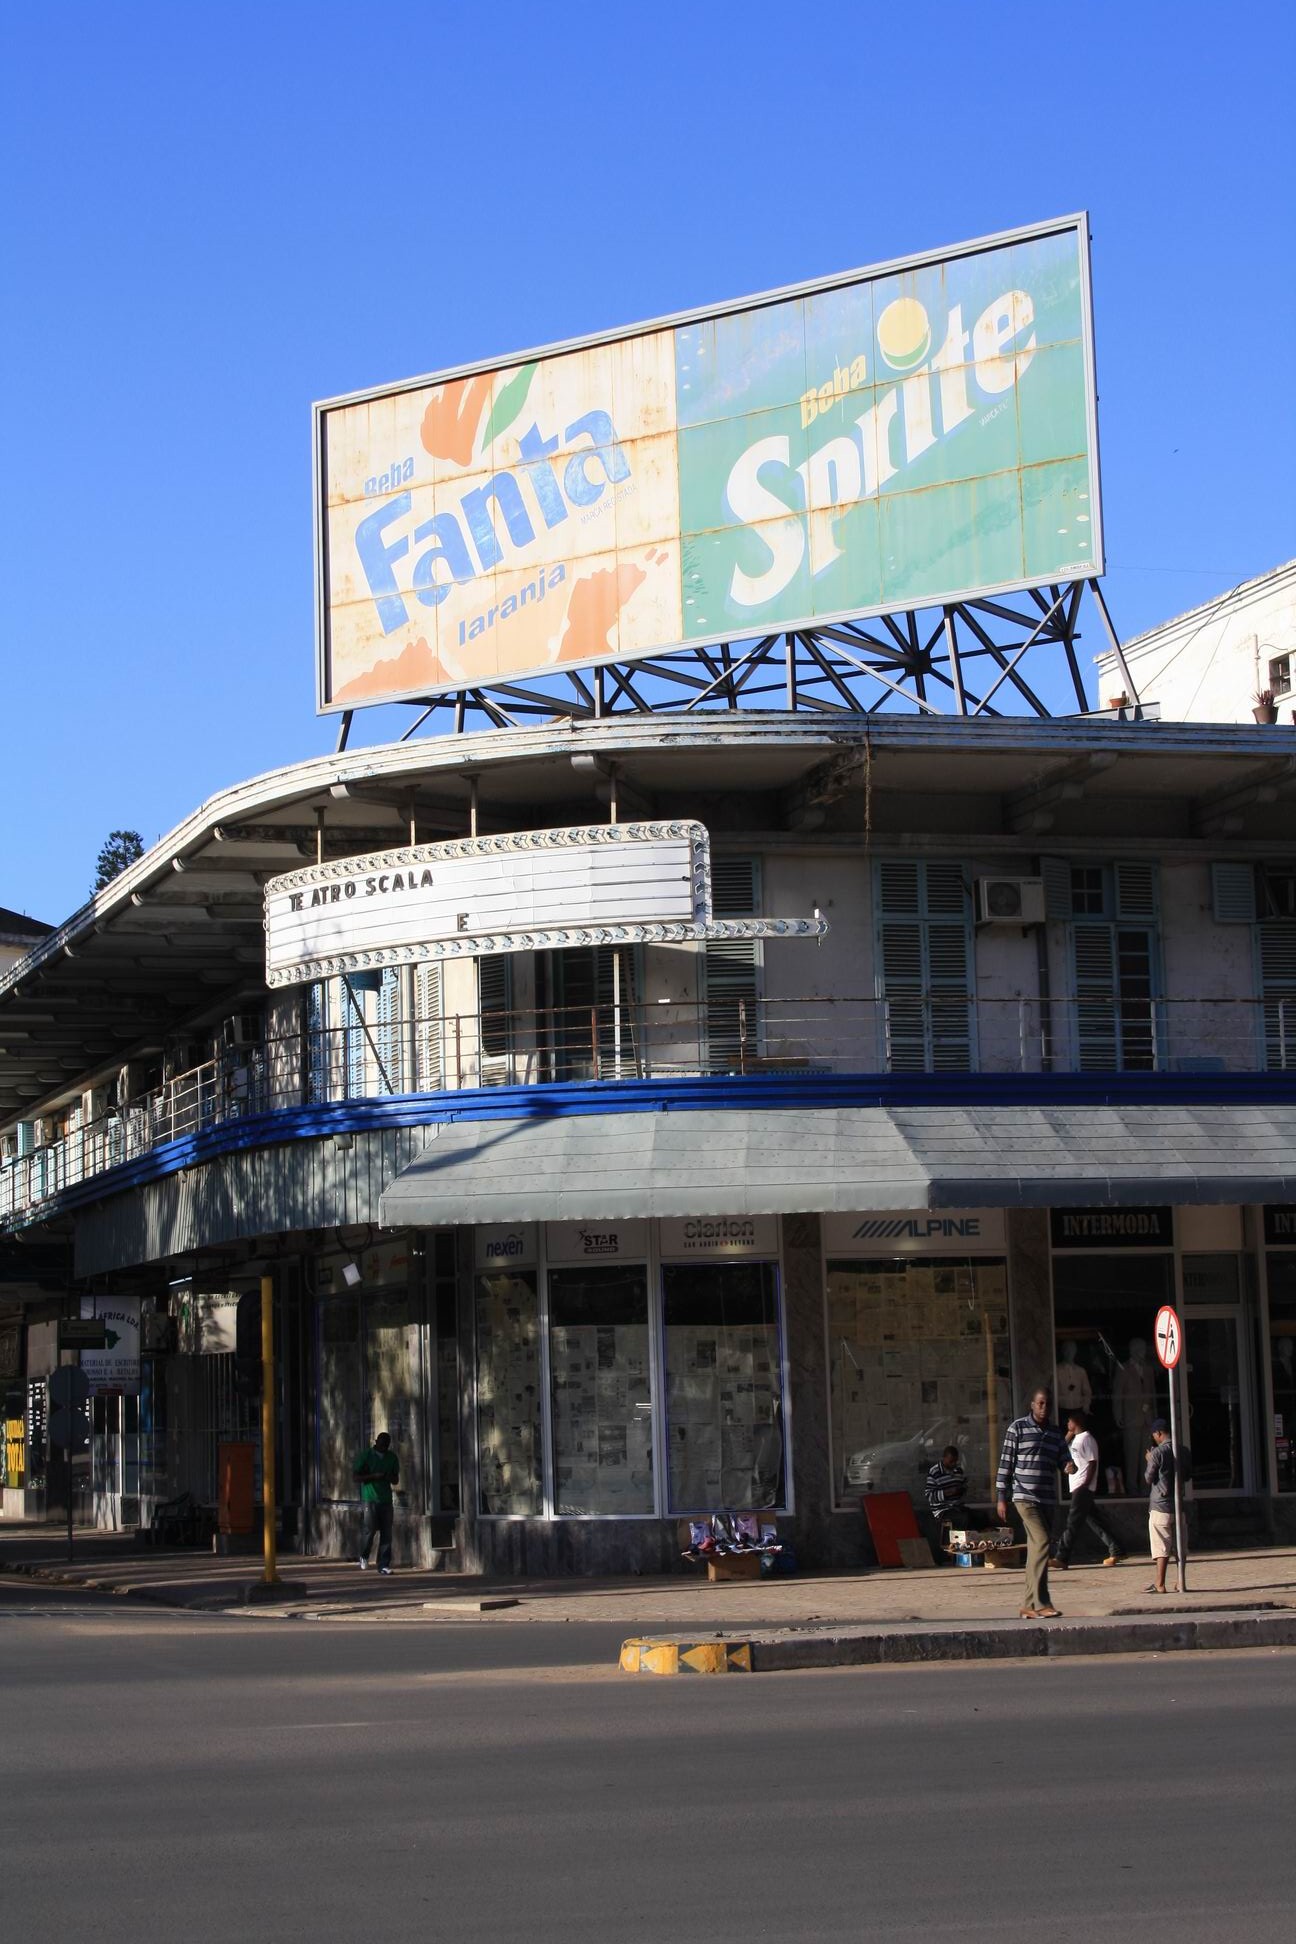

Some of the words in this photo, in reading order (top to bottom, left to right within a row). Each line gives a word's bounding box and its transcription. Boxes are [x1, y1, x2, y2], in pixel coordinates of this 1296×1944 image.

[727, 290, 1036, 606] Sprite
[355, 409, 631, 635] Fanta
[459, 562, 567, 646] laranja
[366, 869, 433, 896] SCALA
[457, 913, 470, 933] E
[684, 1219, 754, 1238] clarion
[889, 1219, 980, 1238] ALPINE
[1063, 1213, 1160, 1236] INTERMODA
[486, 1239, 523, 1257] nexen
[584, 1234, 618, 1246] STAR
